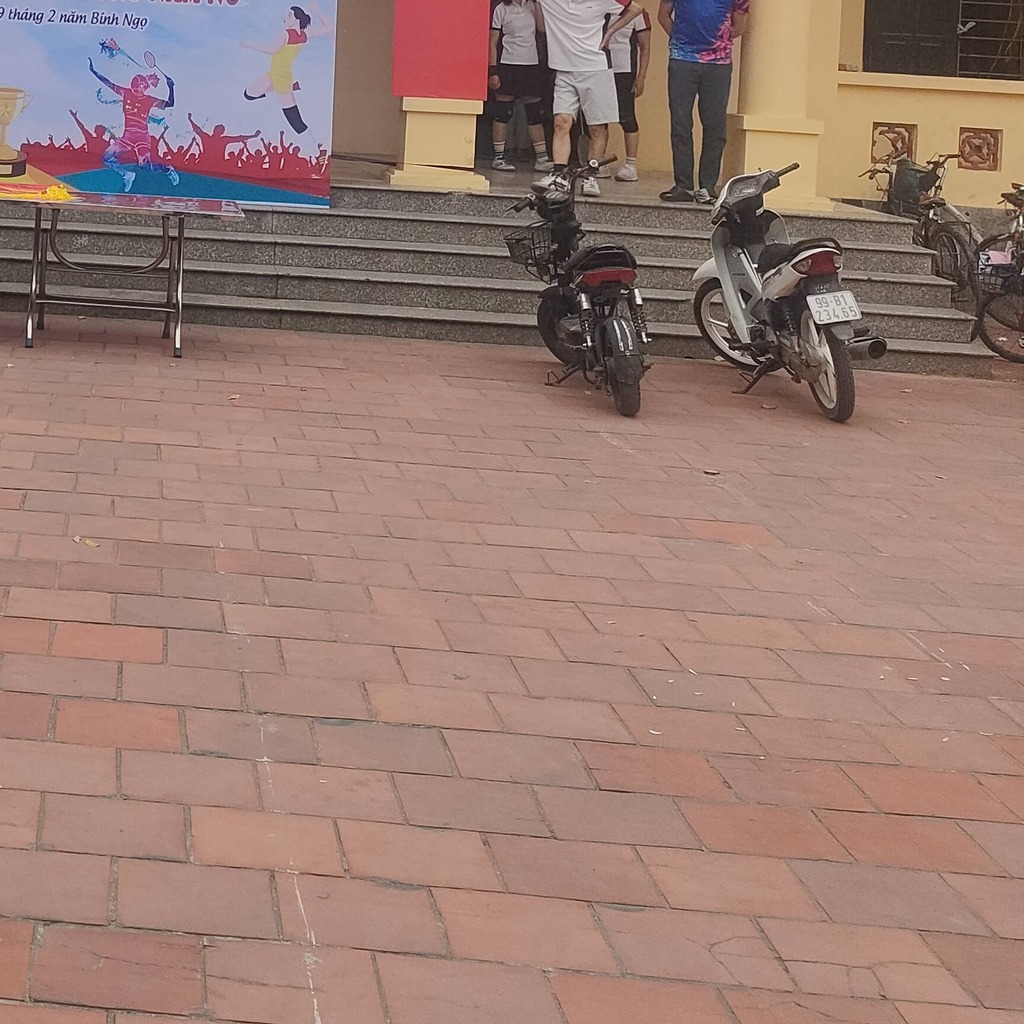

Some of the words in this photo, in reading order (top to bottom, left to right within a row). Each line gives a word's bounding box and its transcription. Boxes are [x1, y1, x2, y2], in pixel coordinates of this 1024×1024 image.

[8, 7, 45, 24] tháng
[47, 9, 56, 23] 2
[59, 11, 87, 24] năm
[90, 11, 119, 26] Bính
[122, 13, 148, 30] Ngọ
[814, 294, 848, 309] 99-B1
